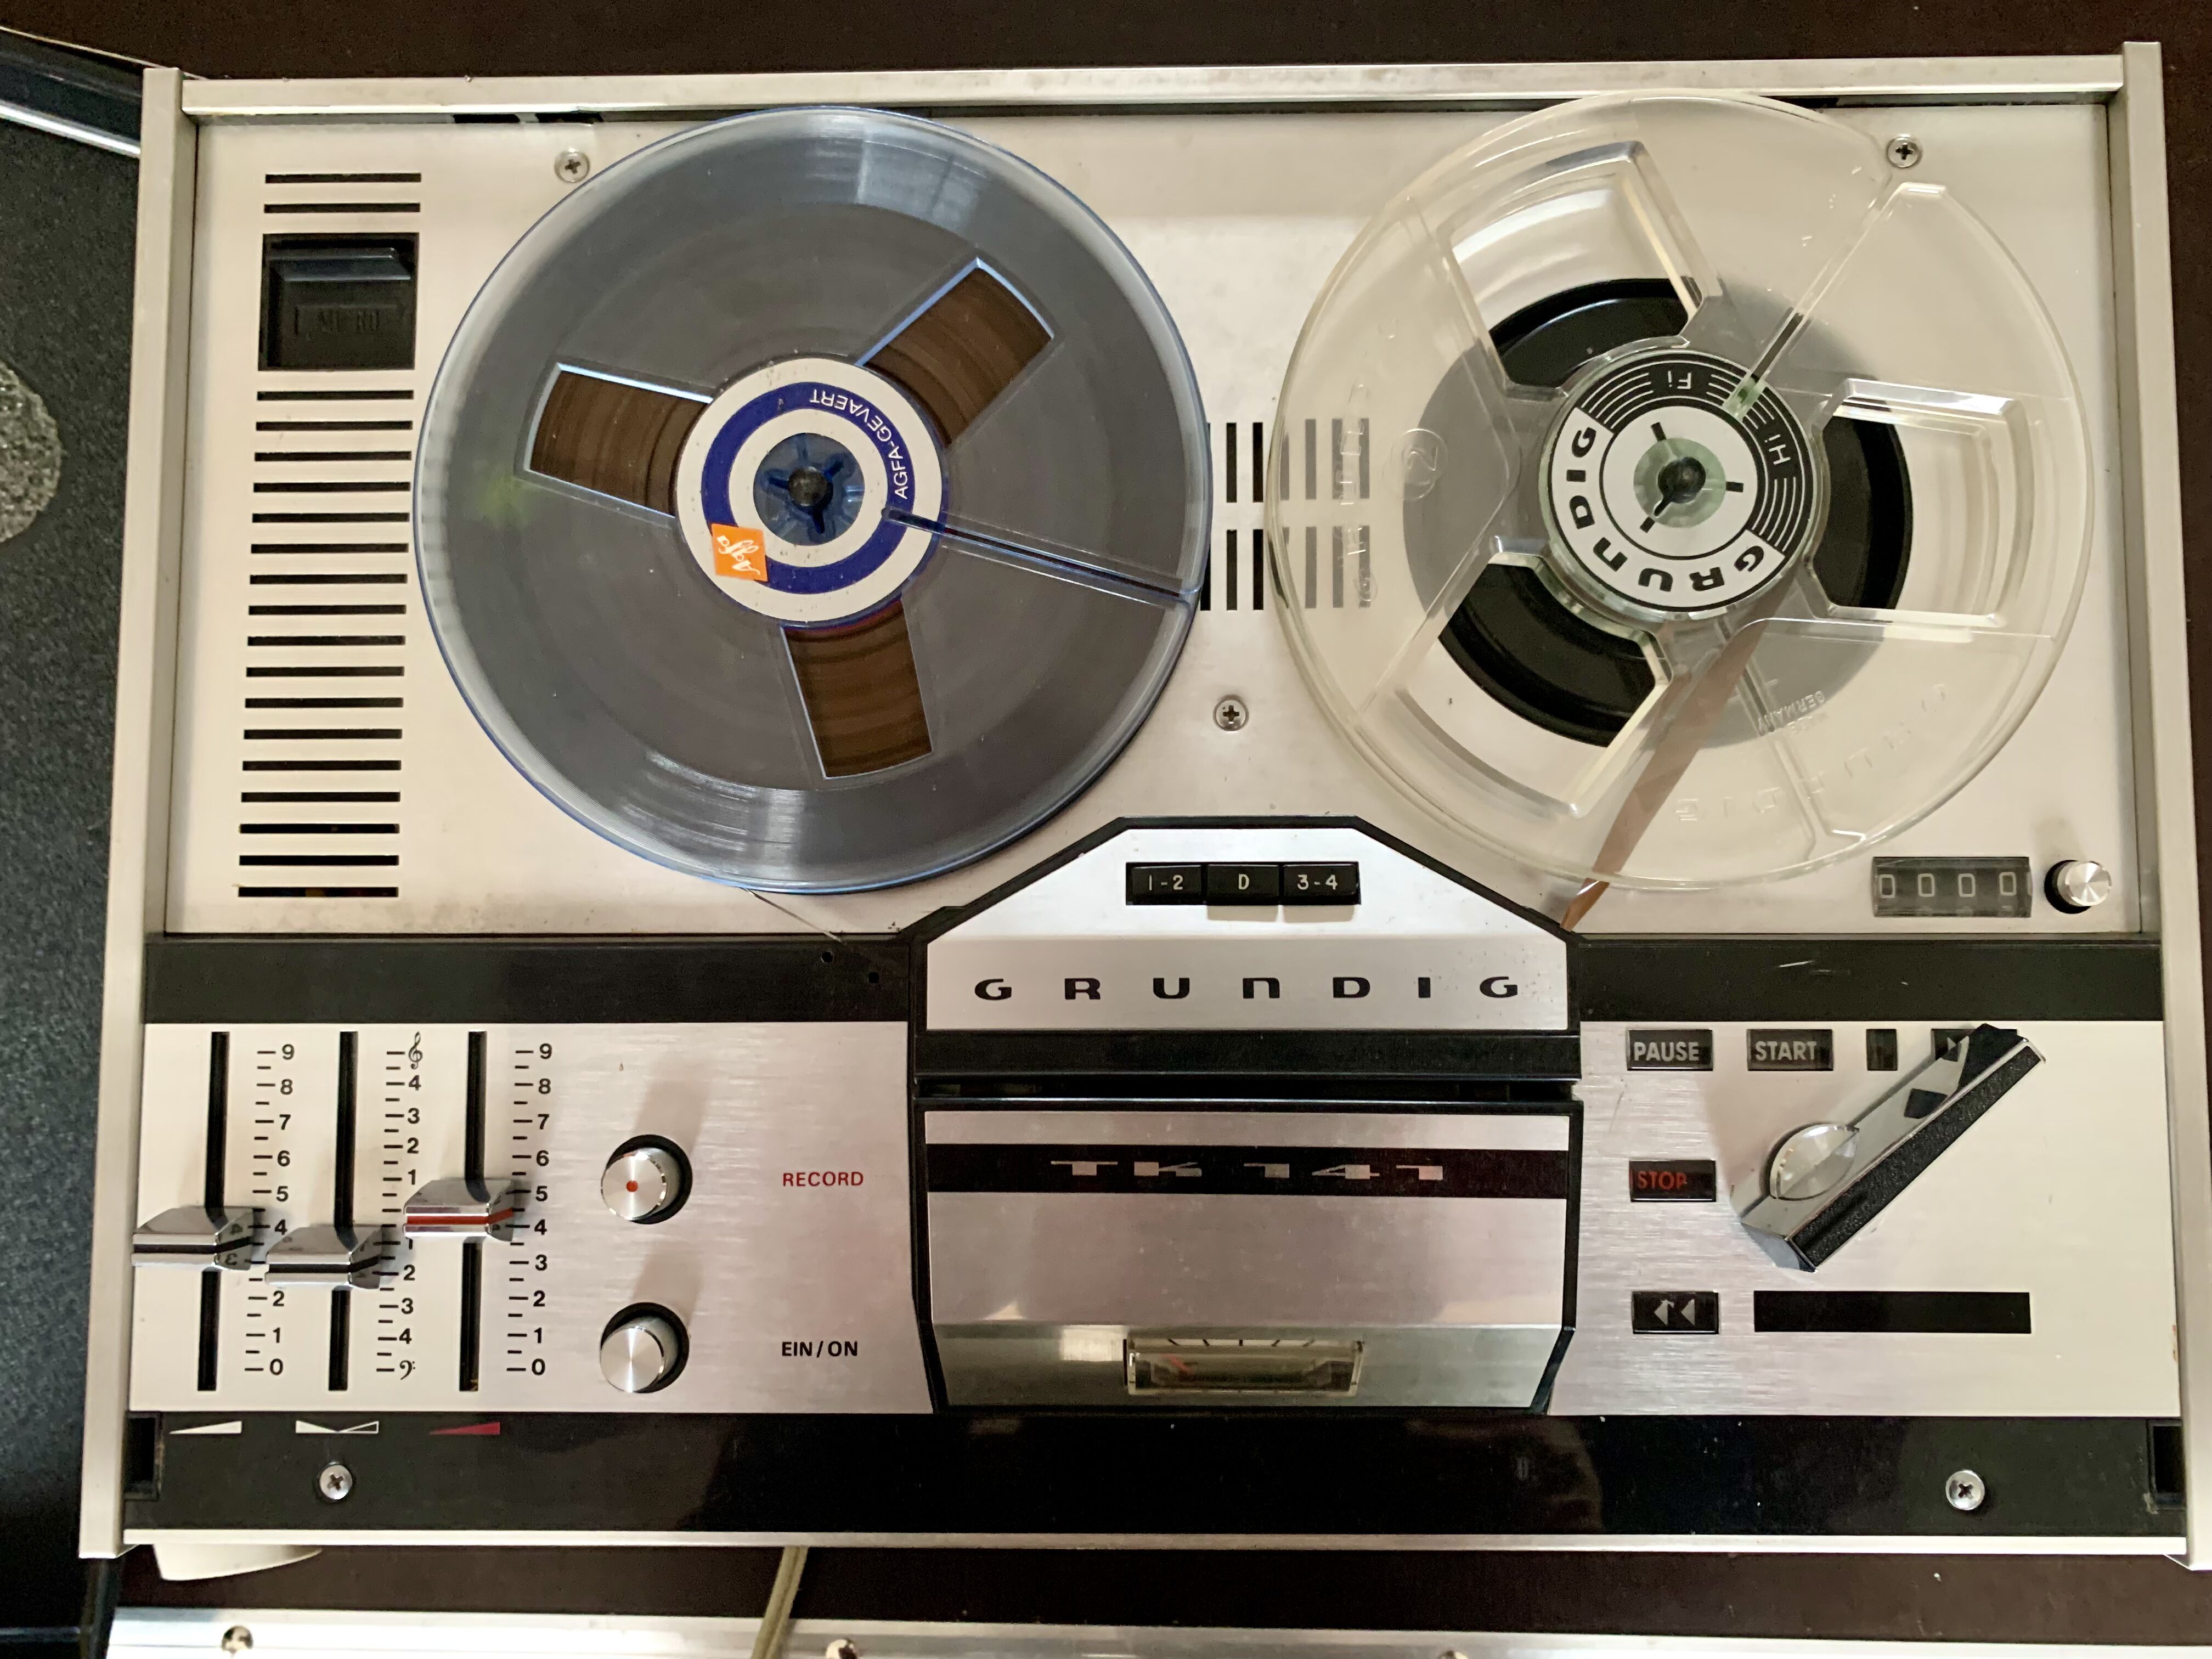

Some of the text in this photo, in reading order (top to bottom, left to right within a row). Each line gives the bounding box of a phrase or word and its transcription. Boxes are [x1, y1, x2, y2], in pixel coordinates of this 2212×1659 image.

[1668, 370, 1791, 465] Hi Fi
[810, 388, 910, 500] AGFA-GEVAERT
[1565, 426, 1765, 592] GRUNDIG
[716, 534, 761, 576] Agfa
[1149, 874, 1338, 890] 1-2 D 3-4
[975, 977, 1517, 1000] GRUNDIG
[283, 1045, 294, 1060] 9
[540, 1043, 552, 1059] 9
[1634, 1041, 1700, 1062] PAUSE
[1755, 1040, 1818, 1061] START
[281, 1079, 292, 1094] 8
[409, 1075, 421, 1090] 4
[539, 1079, 550, 1094] 8
[280, 1114, 291, 1130] 7
[408, 1108, 420, 1124] 3
[538, 1114, 549, 1130] 7
[407, 1138, 419, 1153] 2
[278, 1150, 290, 1166] 6
[537, 1150, 549, 1166] 6
[1051, 1161, 1201, 1176] TK
[408, 1170, 415, 1185] 1
[783, 1171, 863, 1186] RECORD
[1637, 1172, 1688, 1189] STOP
[276, 1186, 288, 1201] 5
[535, 1186, 548, 1201] 5
[275, 1220, 287, 1235] 4
[534, 1220, 547, 1235] 4
[535, 1255, 547, 1271] 3
[404, 1265, 415, 1280] 2
[273, 1291, 284, 1306] 2
[402, 1298, 413, 1314] 3
[533, 1290, 545, 1306] 2
[273, 1328, 280, 1343] 1
[399, 1328, 411, 1344] 4
[534, 1328, 541, 1343] 1
[270, 1359, 283, 1375] 0
[532, 1361, 545, 1375] 0
